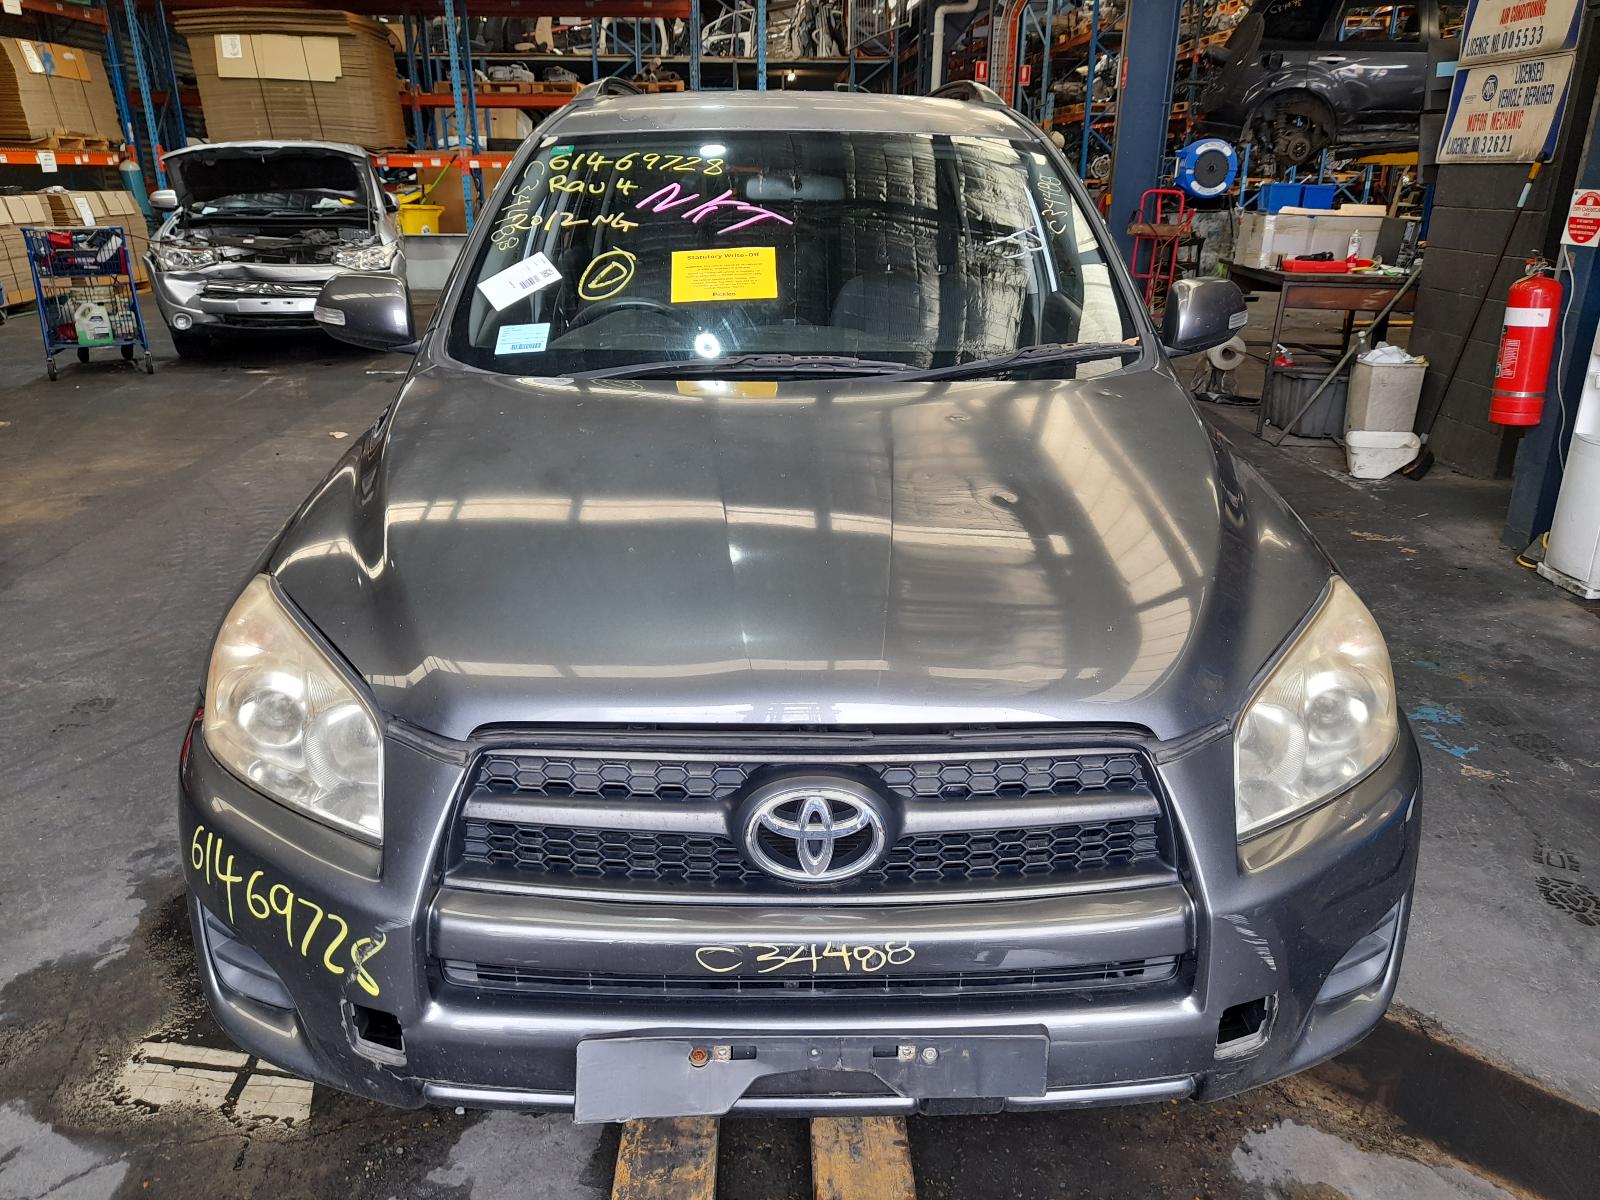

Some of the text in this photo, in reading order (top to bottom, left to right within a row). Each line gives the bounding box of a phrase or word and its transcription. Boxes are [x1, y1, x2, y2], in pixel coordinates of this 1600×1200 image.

[1500, 0, 1547, 24] AIR CONDITIONING
[1466, 35, 1490, 56] LICENCE
[1501, 25, 1543, 50] 005533
[1514, 62, 1544, 84] LICENSED
[1498, 88, 1523, 108] VEHICLE
[1523, 84, 1555, 107] REPAIRER
[1466, 110, 1524, 132] MOTOR MECHANIC
[1446, 137, 1470, 155] LICENCE
[1481, 135, 1512, 153] 32621
